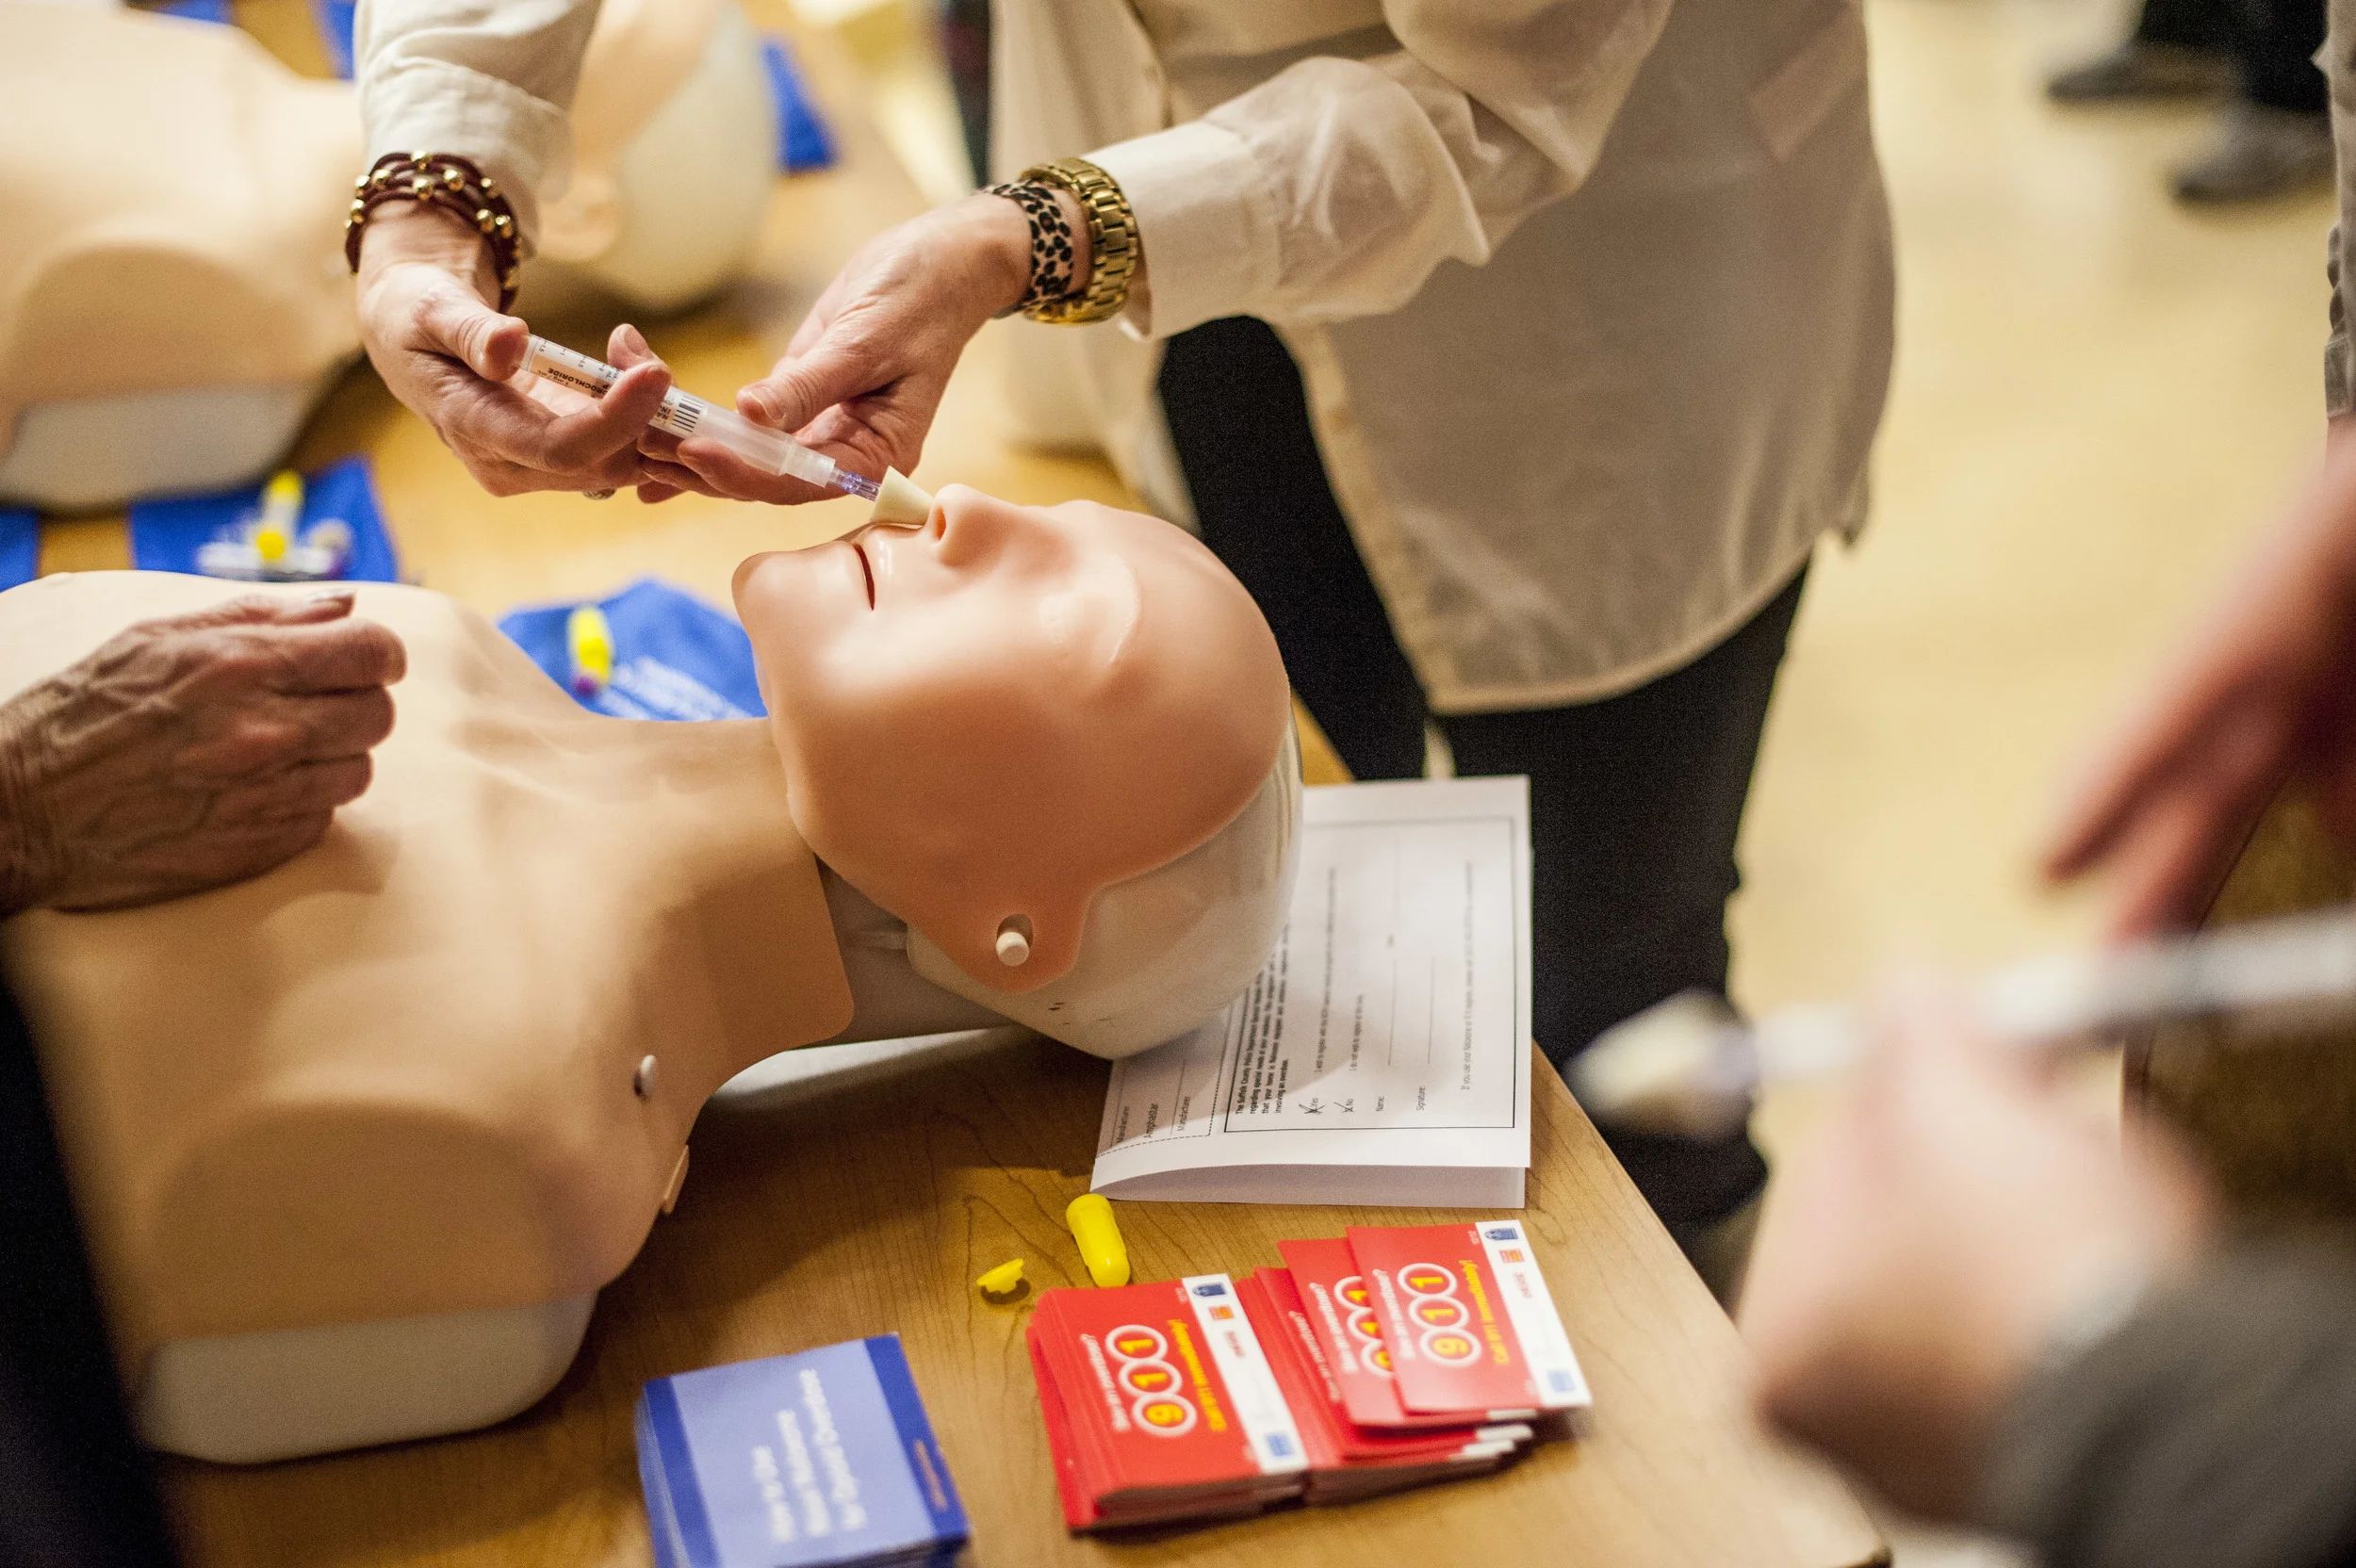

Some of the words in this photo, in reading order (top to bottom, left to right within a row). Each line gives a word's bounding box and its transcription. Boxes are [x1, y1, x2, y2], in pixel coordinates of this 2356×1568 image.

[1463, 1028, 1472, 1051] Naloxone
[1463, 1064, 1471, 1073] use
[1464, 1052, 1472, 1062] your
[1240, 1068, 1252, 1085] County
[1253, 1071, 1262, 1088] special
[1265, 1072, 1274, 1086] home
[1463, 1074, 1471, 1085] you
[1237, 1086, 1248, 1103] Suffolk
[1250, 1089, 1261, 1114] regarding
[1274, 1089, 1285, 1113] involving
[1309, 1098, 1318, 1107] Yes
[1376, 1096, 1384, 1111] Name:
[1415, 1086, 1426, 1111] Signature:
[1143, 1103, 1158, 1138] Amphastar
[1235, 1104, 1244, 1114] The
[1372, 1269, 1402, 1321] overdose?
[1459, 1260, 1494, 1322] immediately!
[1308, 1282, 1343, 1334] overdose?
[1411, 1277, 1469, 1355] 911
[1079, 1333, 1114, 1388] overdose?
[1168, 1319, 1208, 1387] immediately!
[1119, 1338, 1184, 1426] 911
